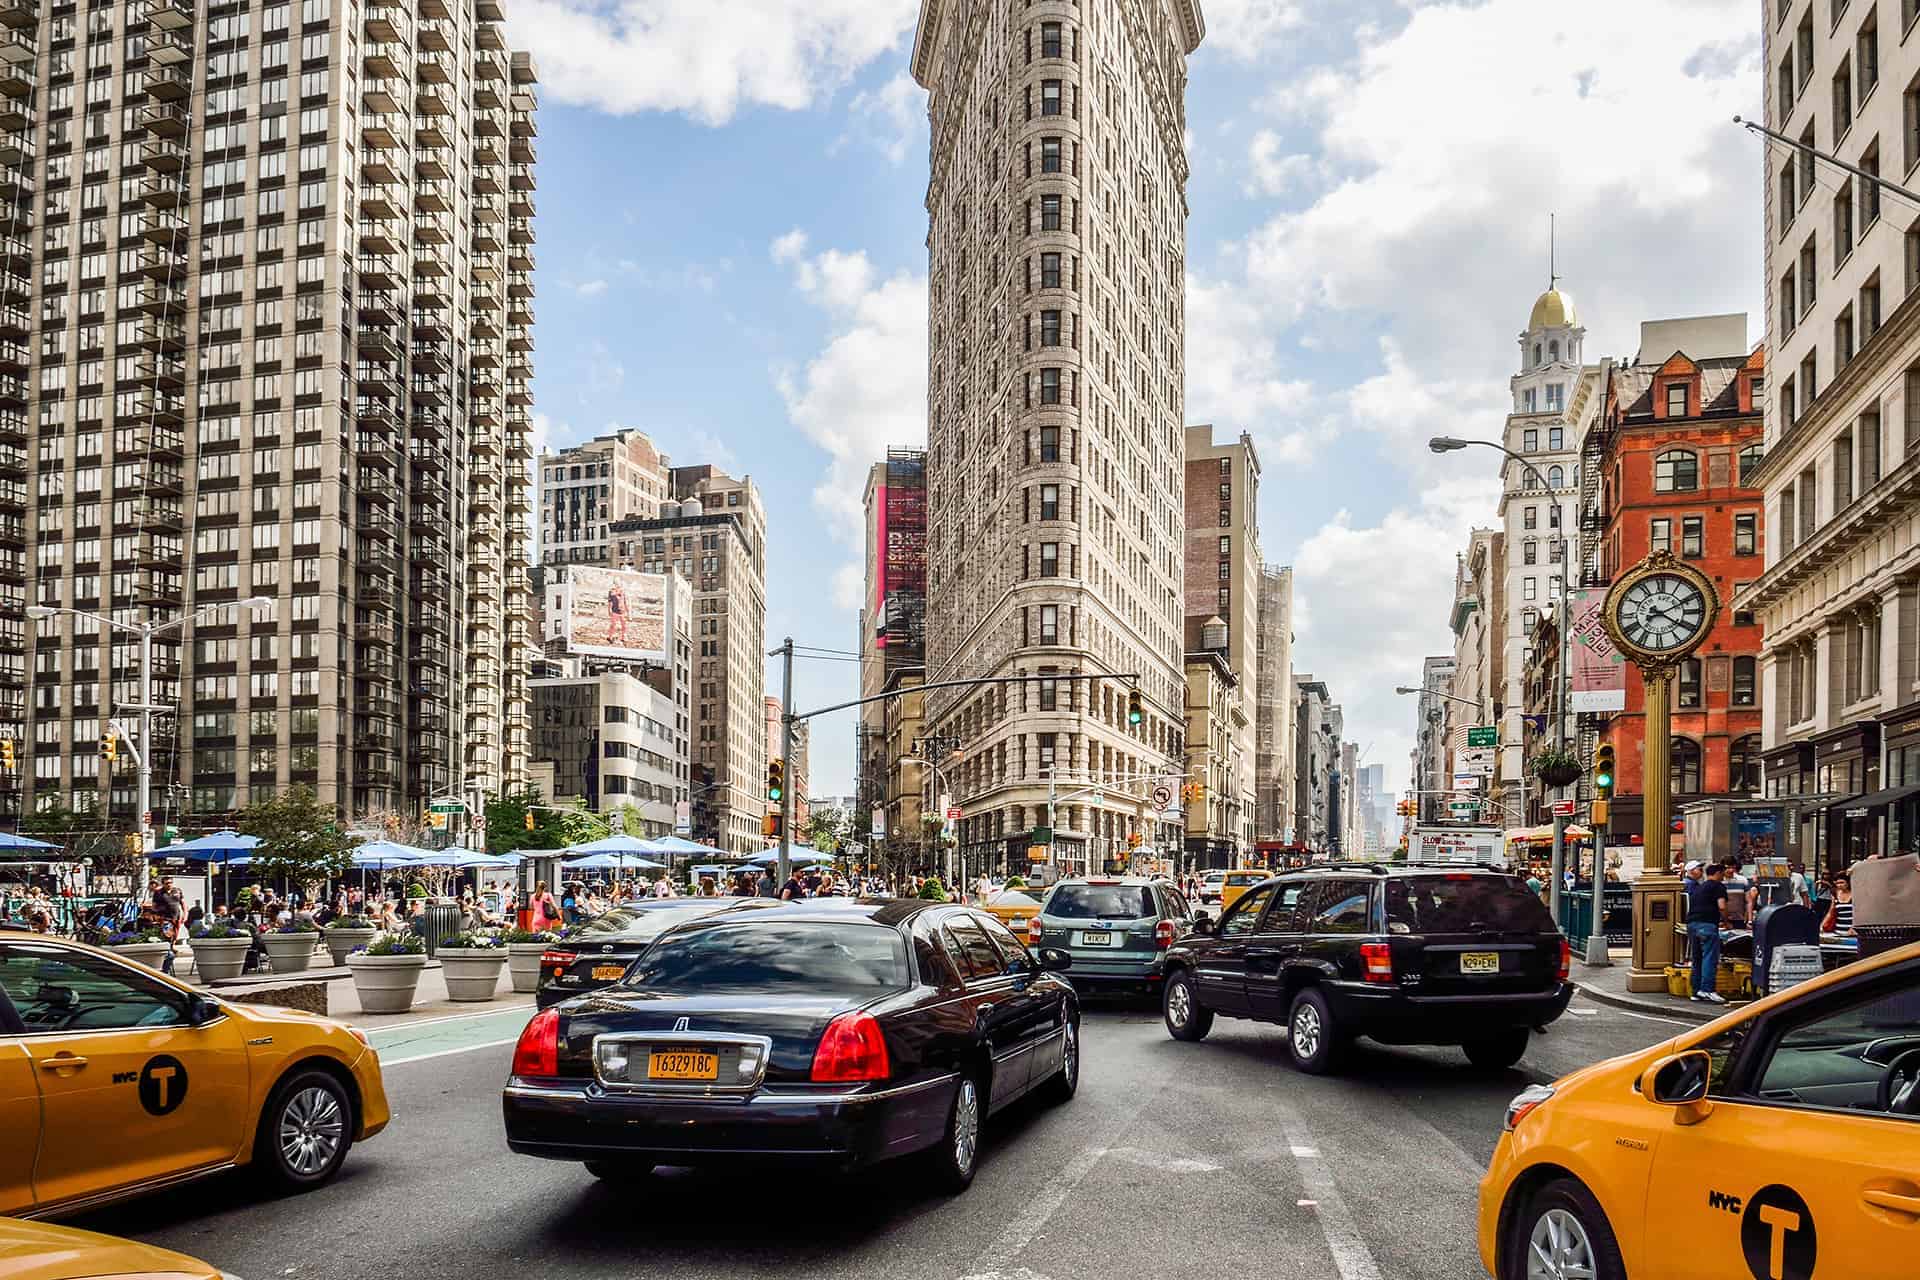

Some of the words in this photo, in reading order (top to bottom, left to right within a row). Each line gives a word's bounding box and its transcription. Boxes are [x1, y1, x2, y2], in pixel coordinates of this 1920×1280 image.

[1423, 836, 1442, 844] SLOW
[655, 1054, 712, 1073] T632918C
[112, 1071, 138, 1084] NYC
[150, 1066, 176, 1107] T
[1708, 1190, 1742, 1214] NYC
[1759, 1204, 1800, 1280] T
